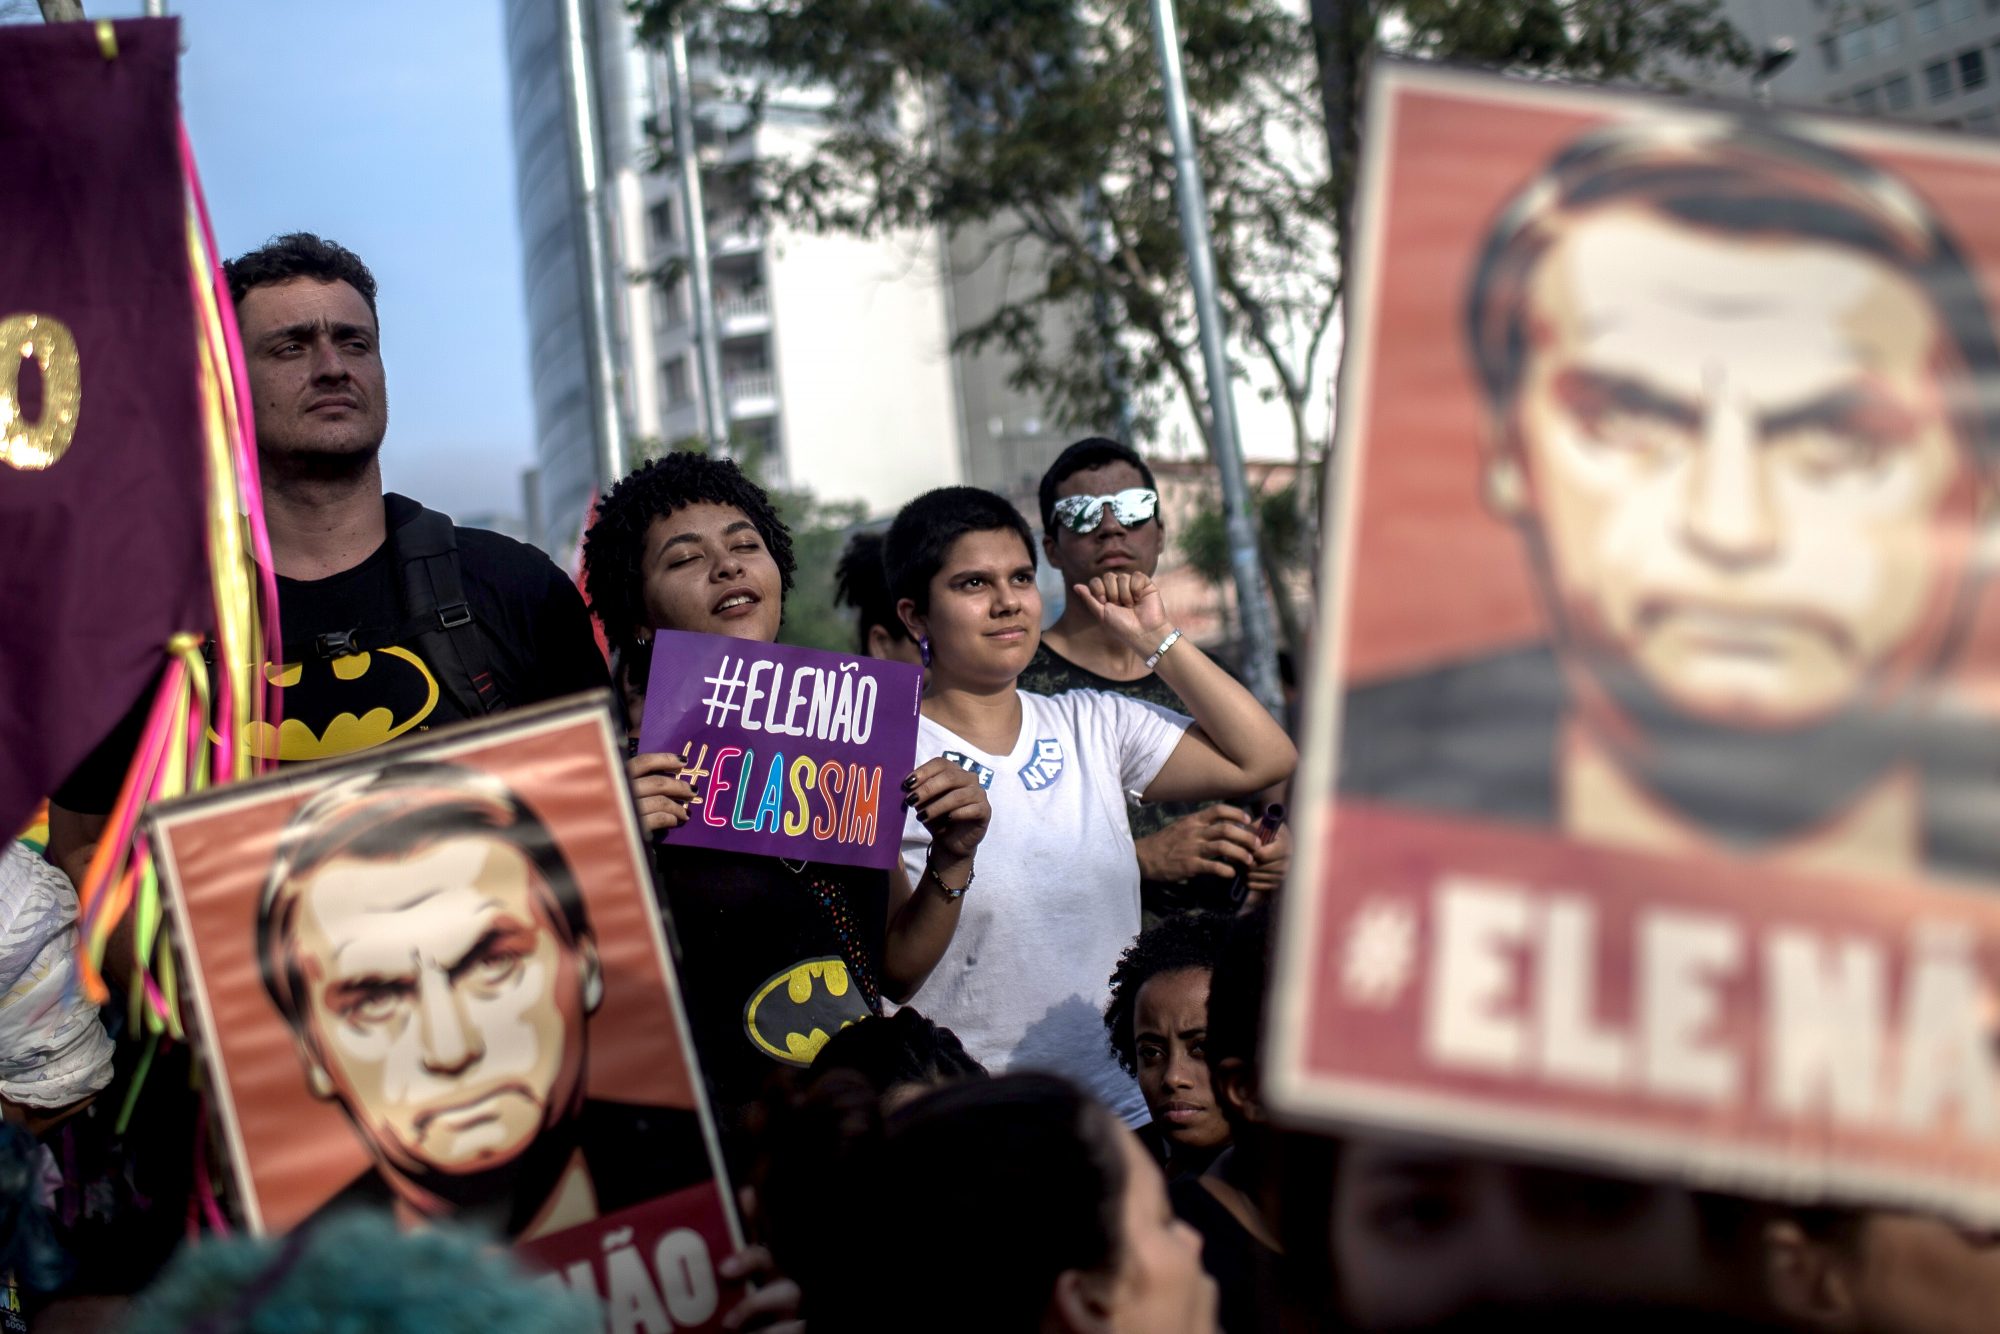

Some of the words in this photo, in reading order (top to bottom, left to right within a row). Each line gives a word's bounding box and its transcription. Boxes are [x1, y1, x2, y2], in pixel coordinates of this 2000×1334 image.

[702, 655, 878, 745] #ELENÃO
[676, 740, 882, 846] #ELASSIM
[1023, 740, 1063, 789] NÃO
